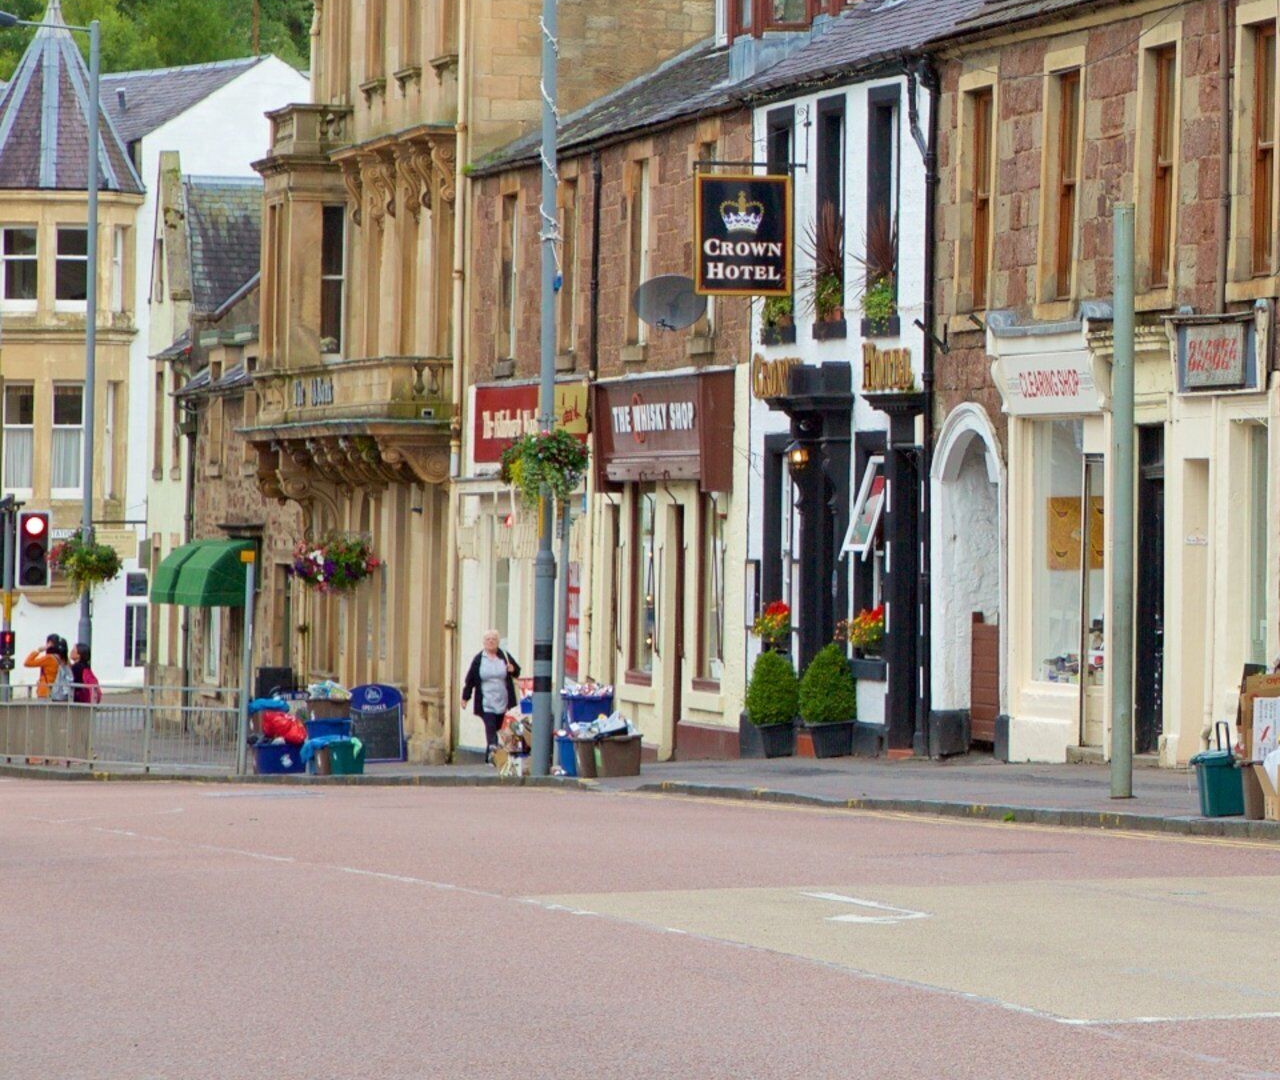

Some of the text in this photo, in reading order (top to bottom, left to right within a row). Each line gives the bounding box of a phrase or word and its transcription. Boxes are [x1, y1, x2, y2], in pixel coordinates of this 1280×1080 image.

[703, 238, 782, 256] CROWN
[706, 262, 780, 280] HOTEL
[753, 342, 912, 399] CROW HOTEL
[1057, 369, 1079, 397] SHOP
[612, 406, 632, 433] THE
[632, 403, 667, 432] WHISKY
[669, 402, 694, 430] SHOP
